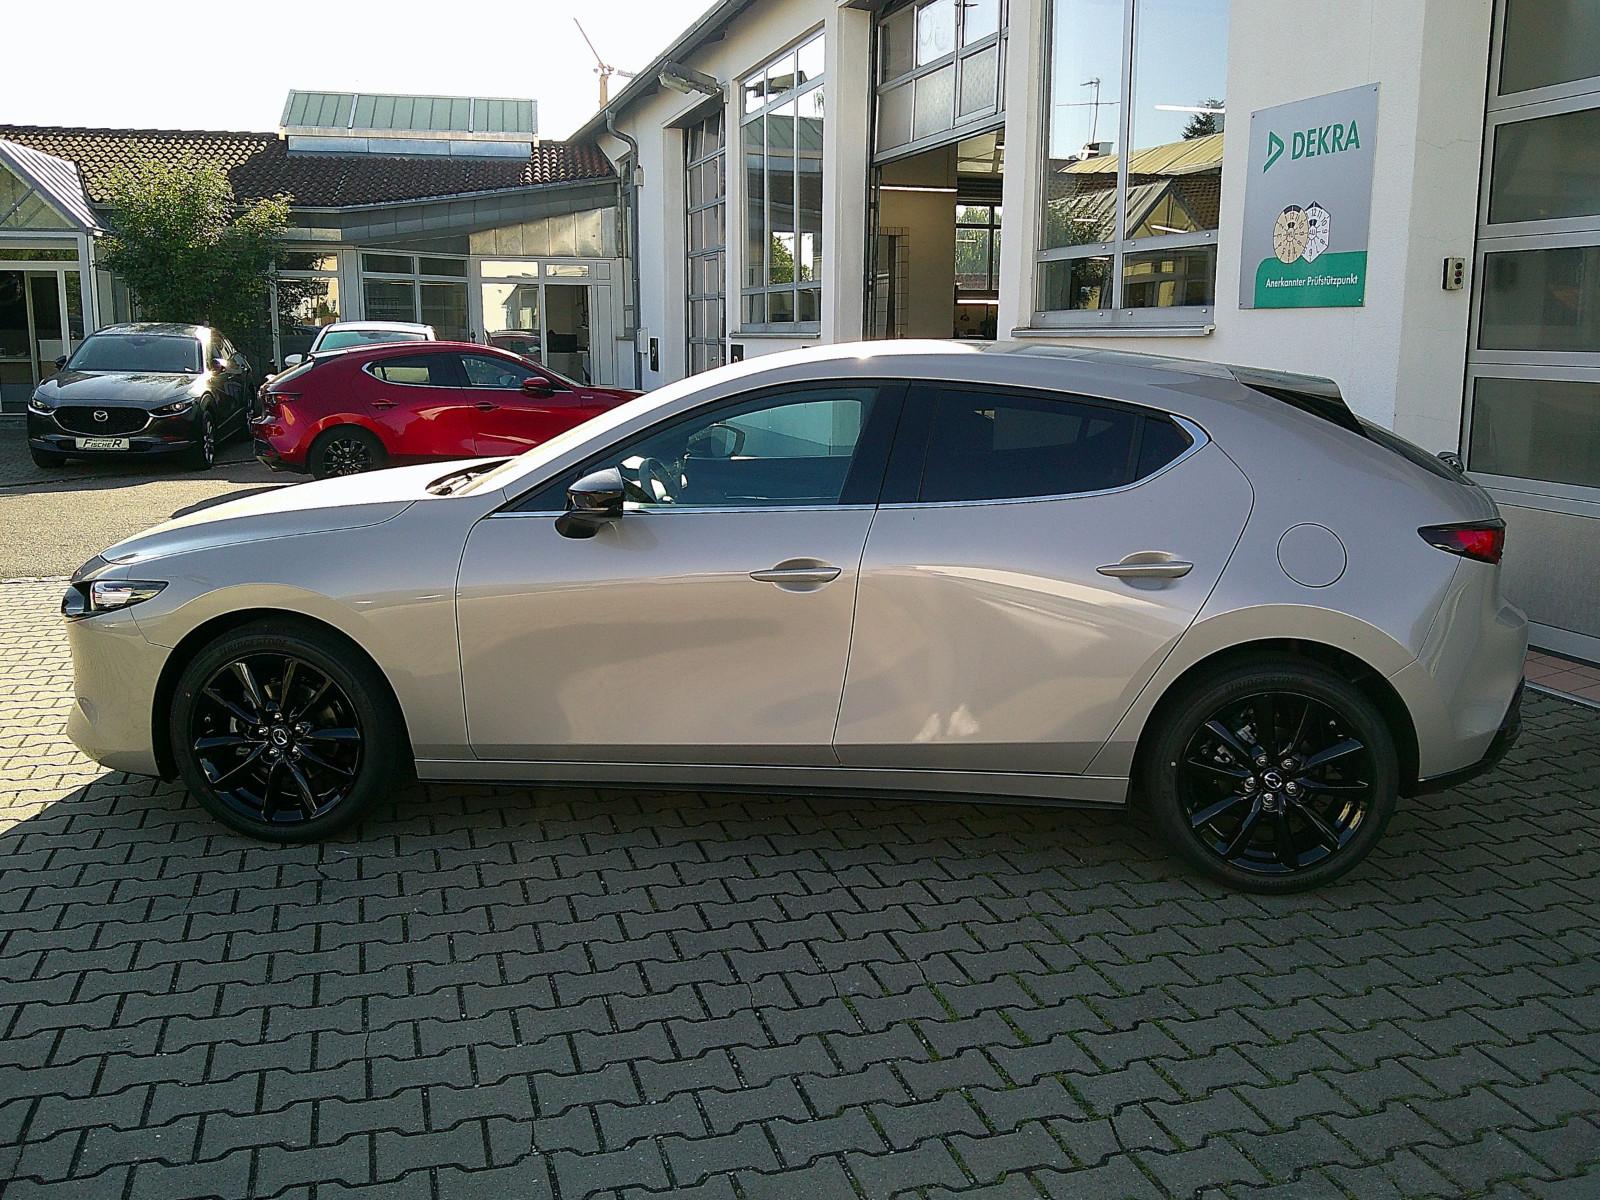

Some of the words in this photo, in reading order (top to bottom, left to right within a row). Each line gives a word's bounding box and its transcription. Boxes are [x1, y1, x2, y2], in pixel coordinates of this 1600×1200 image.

[1292, 120, 1360, 160] DEKRA
[1265, 277, 1305, 288] Anerkannter
[1307, 273, 1358, 288] Prüfstützpunkt
